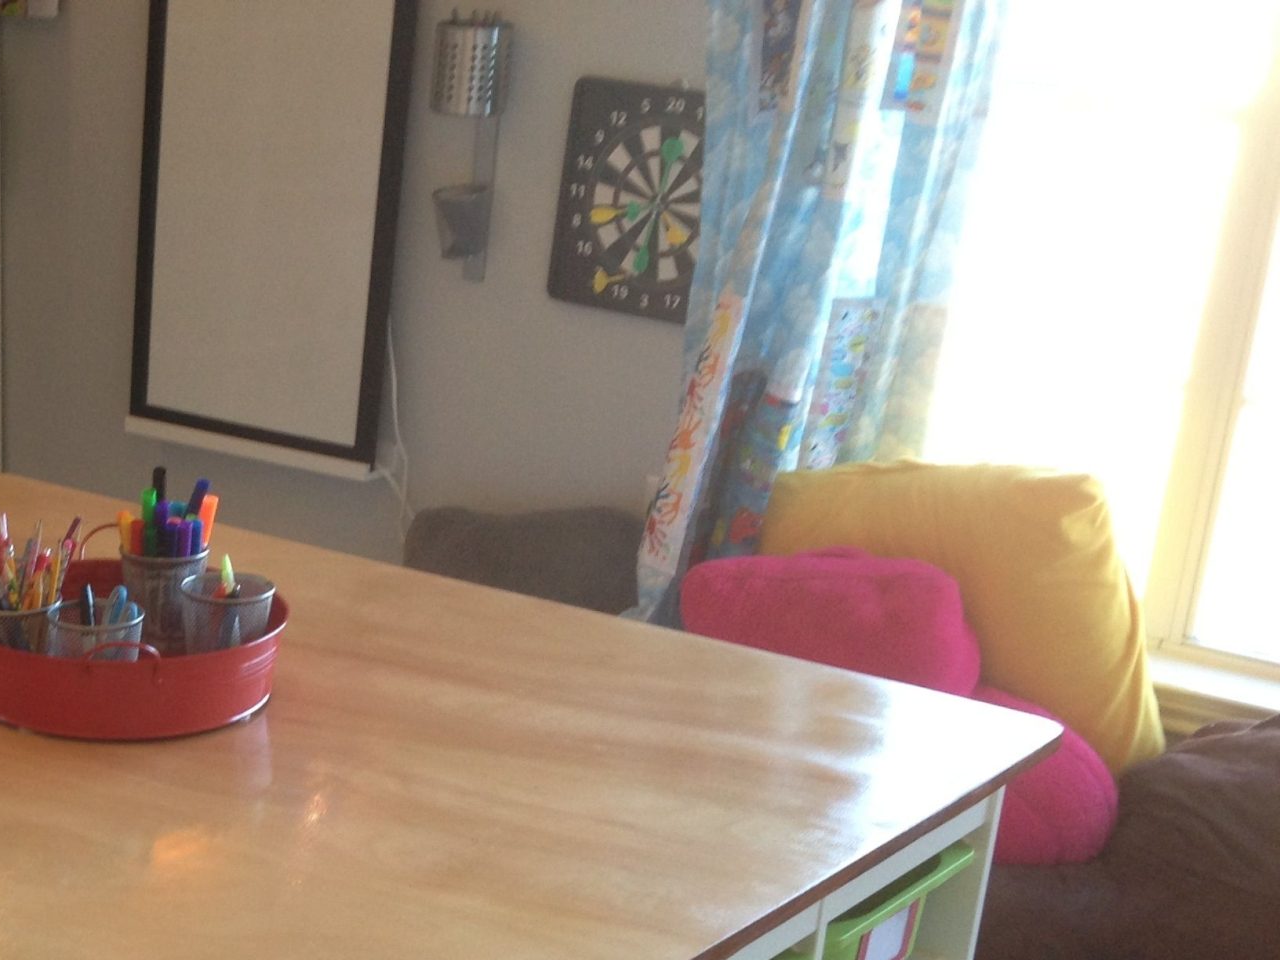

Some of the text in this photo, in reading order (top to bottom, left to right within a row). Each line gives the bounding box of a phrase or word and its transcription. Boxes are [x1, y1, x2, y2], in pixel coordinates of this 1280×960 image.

[641, 98, 651, 114] 5
[665, 97, 686, 114] 20
[610, 111, 627, 127] 12
[577, 154, 594, 170] 14
[570, 182, 586, 199] 11
[577, 241, 593, 256] 16
[612, 284, 629, 300] 19
[641, 294, 650, 308] 3
[664, 294, 681, 309] 17
